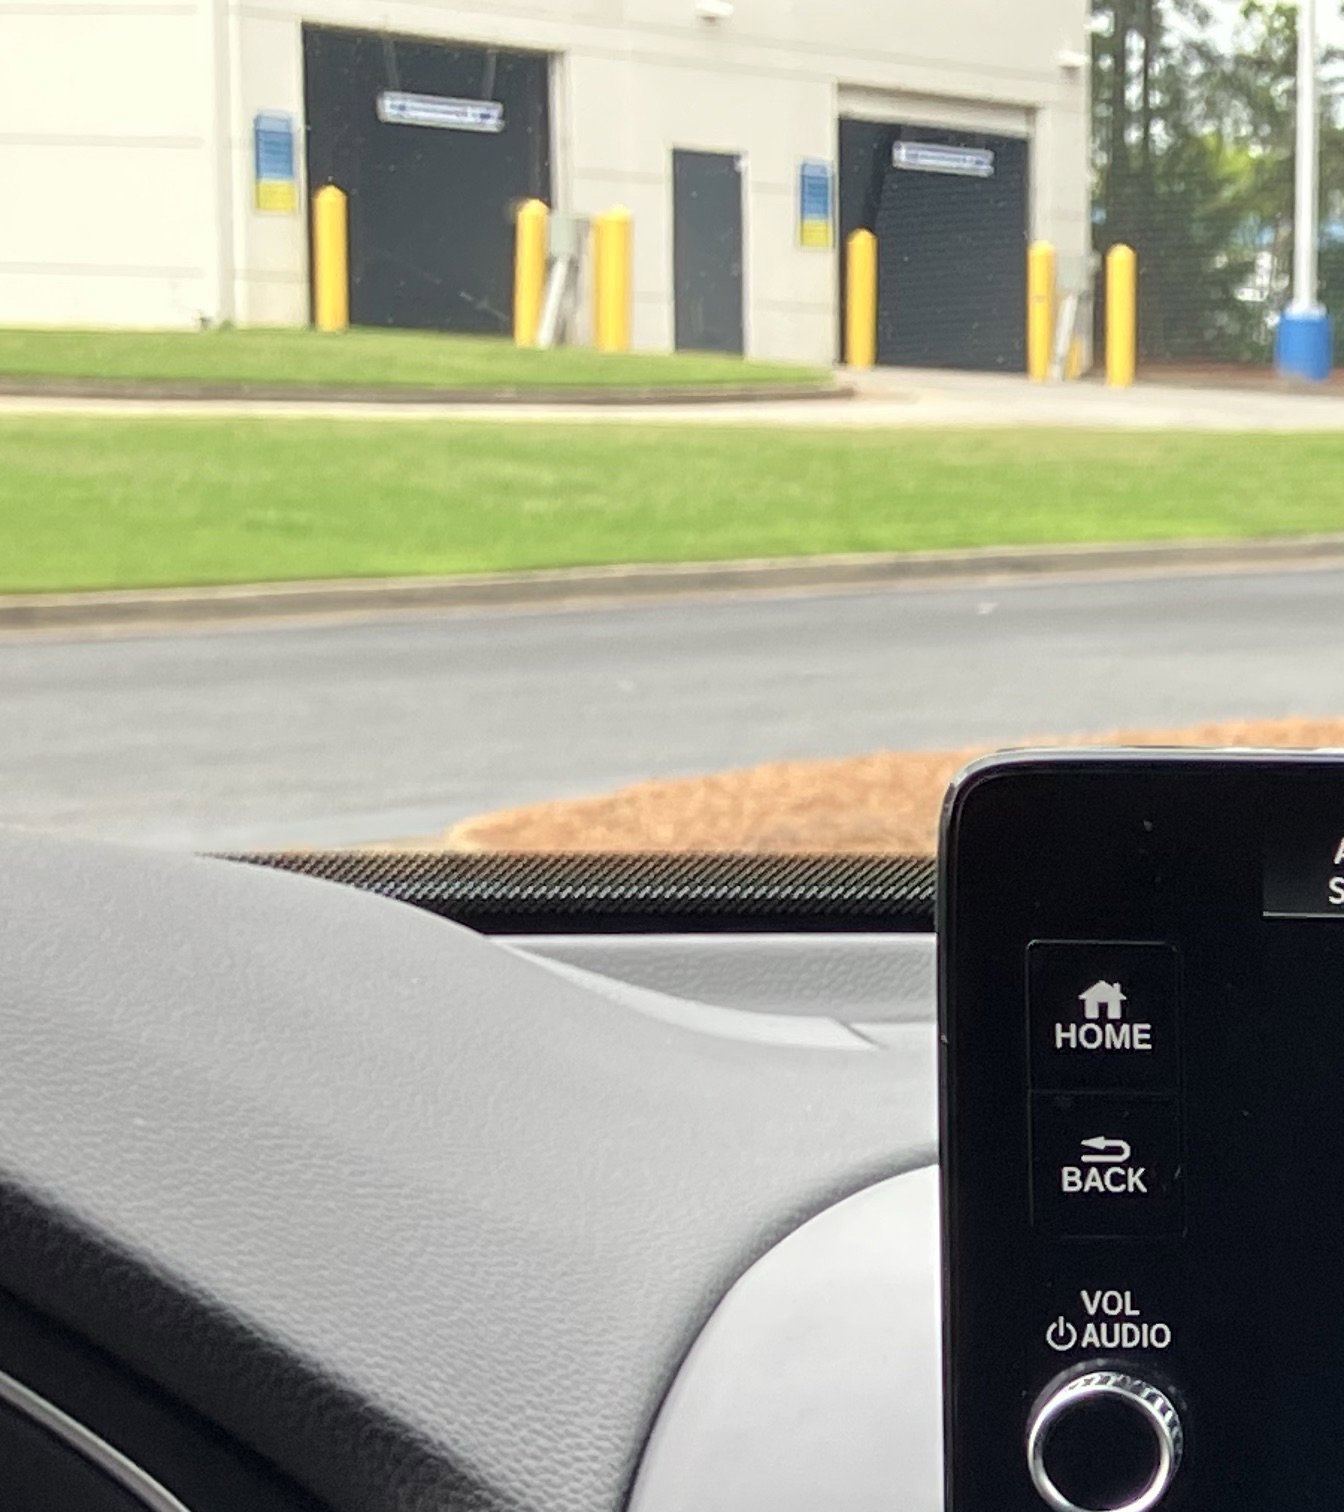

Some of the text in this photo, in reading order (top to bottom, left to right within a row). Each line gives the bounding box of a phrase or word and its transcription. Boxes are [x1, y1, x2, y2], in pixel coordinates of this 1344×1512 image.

[1055, 1022, 1152, 1050] HOME
[1061, 1166, 1148, 1193] BACK
[1080, 1290, 1140, 1316] VOL
[1081, 1322, 1172, 1349] AUDIO
